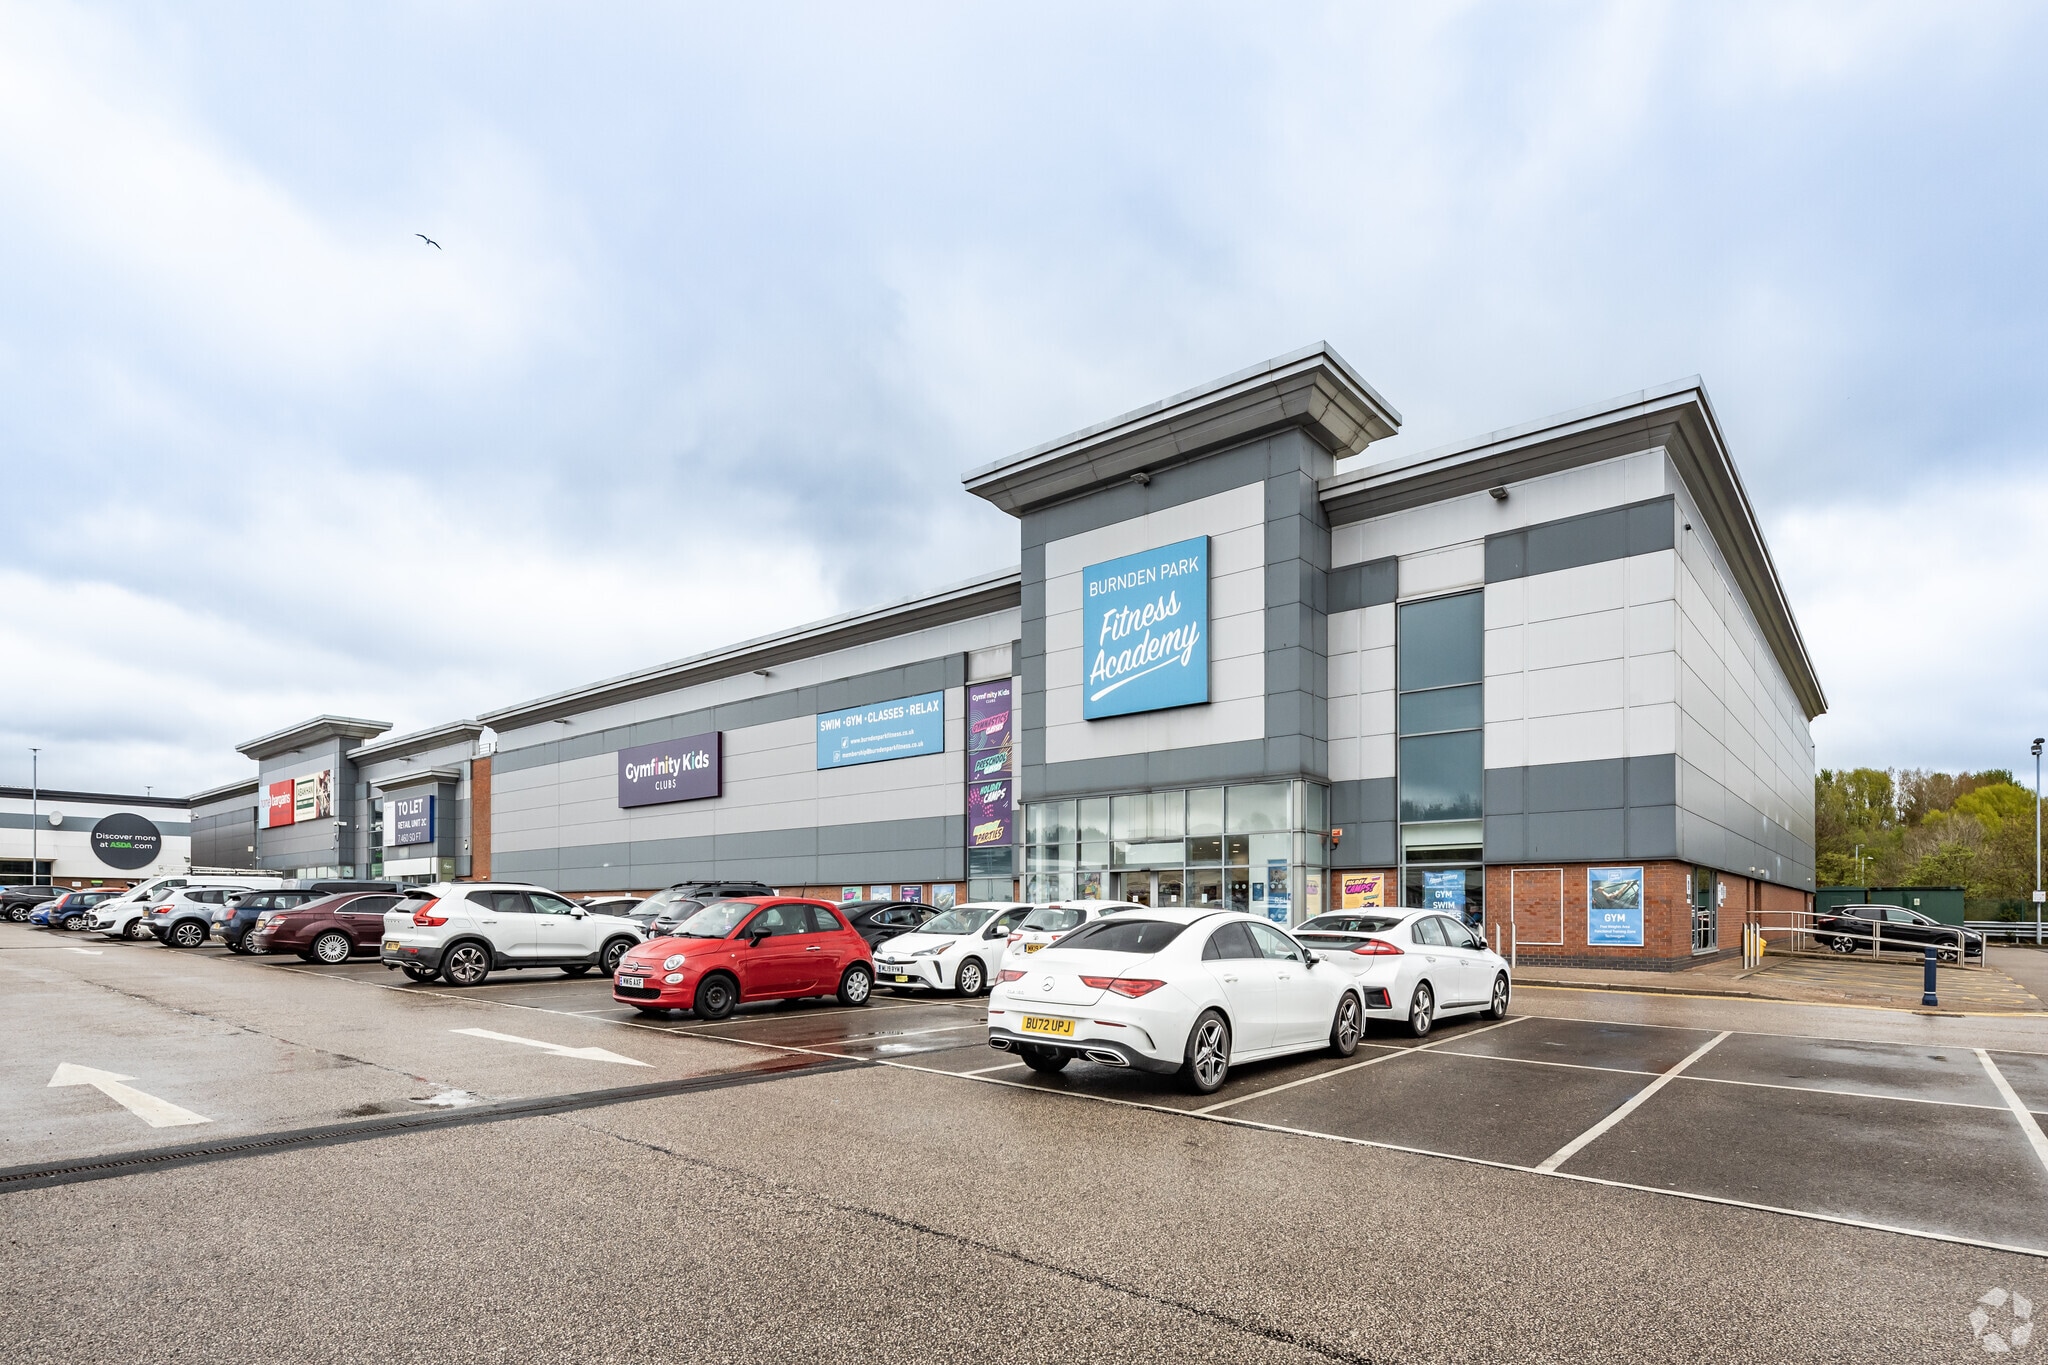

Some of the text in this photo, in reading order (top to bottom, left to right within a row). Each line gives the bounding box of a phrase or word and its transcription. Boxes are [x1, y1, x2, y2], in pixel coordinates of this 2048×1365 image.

[1090, 556, 1199, 597] BURNDEN PARK
[1100, 590, 1181, 646] Fitness
[1090, 621, 1200, 686] Academy
[998, 689, 1010, 697] Kids
[820, 700, 939, 732] SWIM GYM CLASSES RELAX
[974, 712, 1008, 732] GYMNASTICS
[625, 750, 709, 783] Gymfinity Kids
[976, 753, 1006, 770] PRESCHOOL
[655, 779, 676, 790] CLUBS
[980, 781, 1003, 795] HOLIDAY
[272, 792, 291, 808] bargains
[984, 788, 1007, 803] CAMPS
[398, 799, 423, 816] TO LET
[398, 820, 411, 829] RETAIL
[411, 819, 421, 828] UNIT
[416, 832, 421, 840] FT
[1345, 882, 1377, 894] CAMPS!
[1433, 901, 1455, 909] SWIM
[1604, 914, 1626, 922] GYM
[1026, 1017, 1071, 1032] BU72 UPJ
